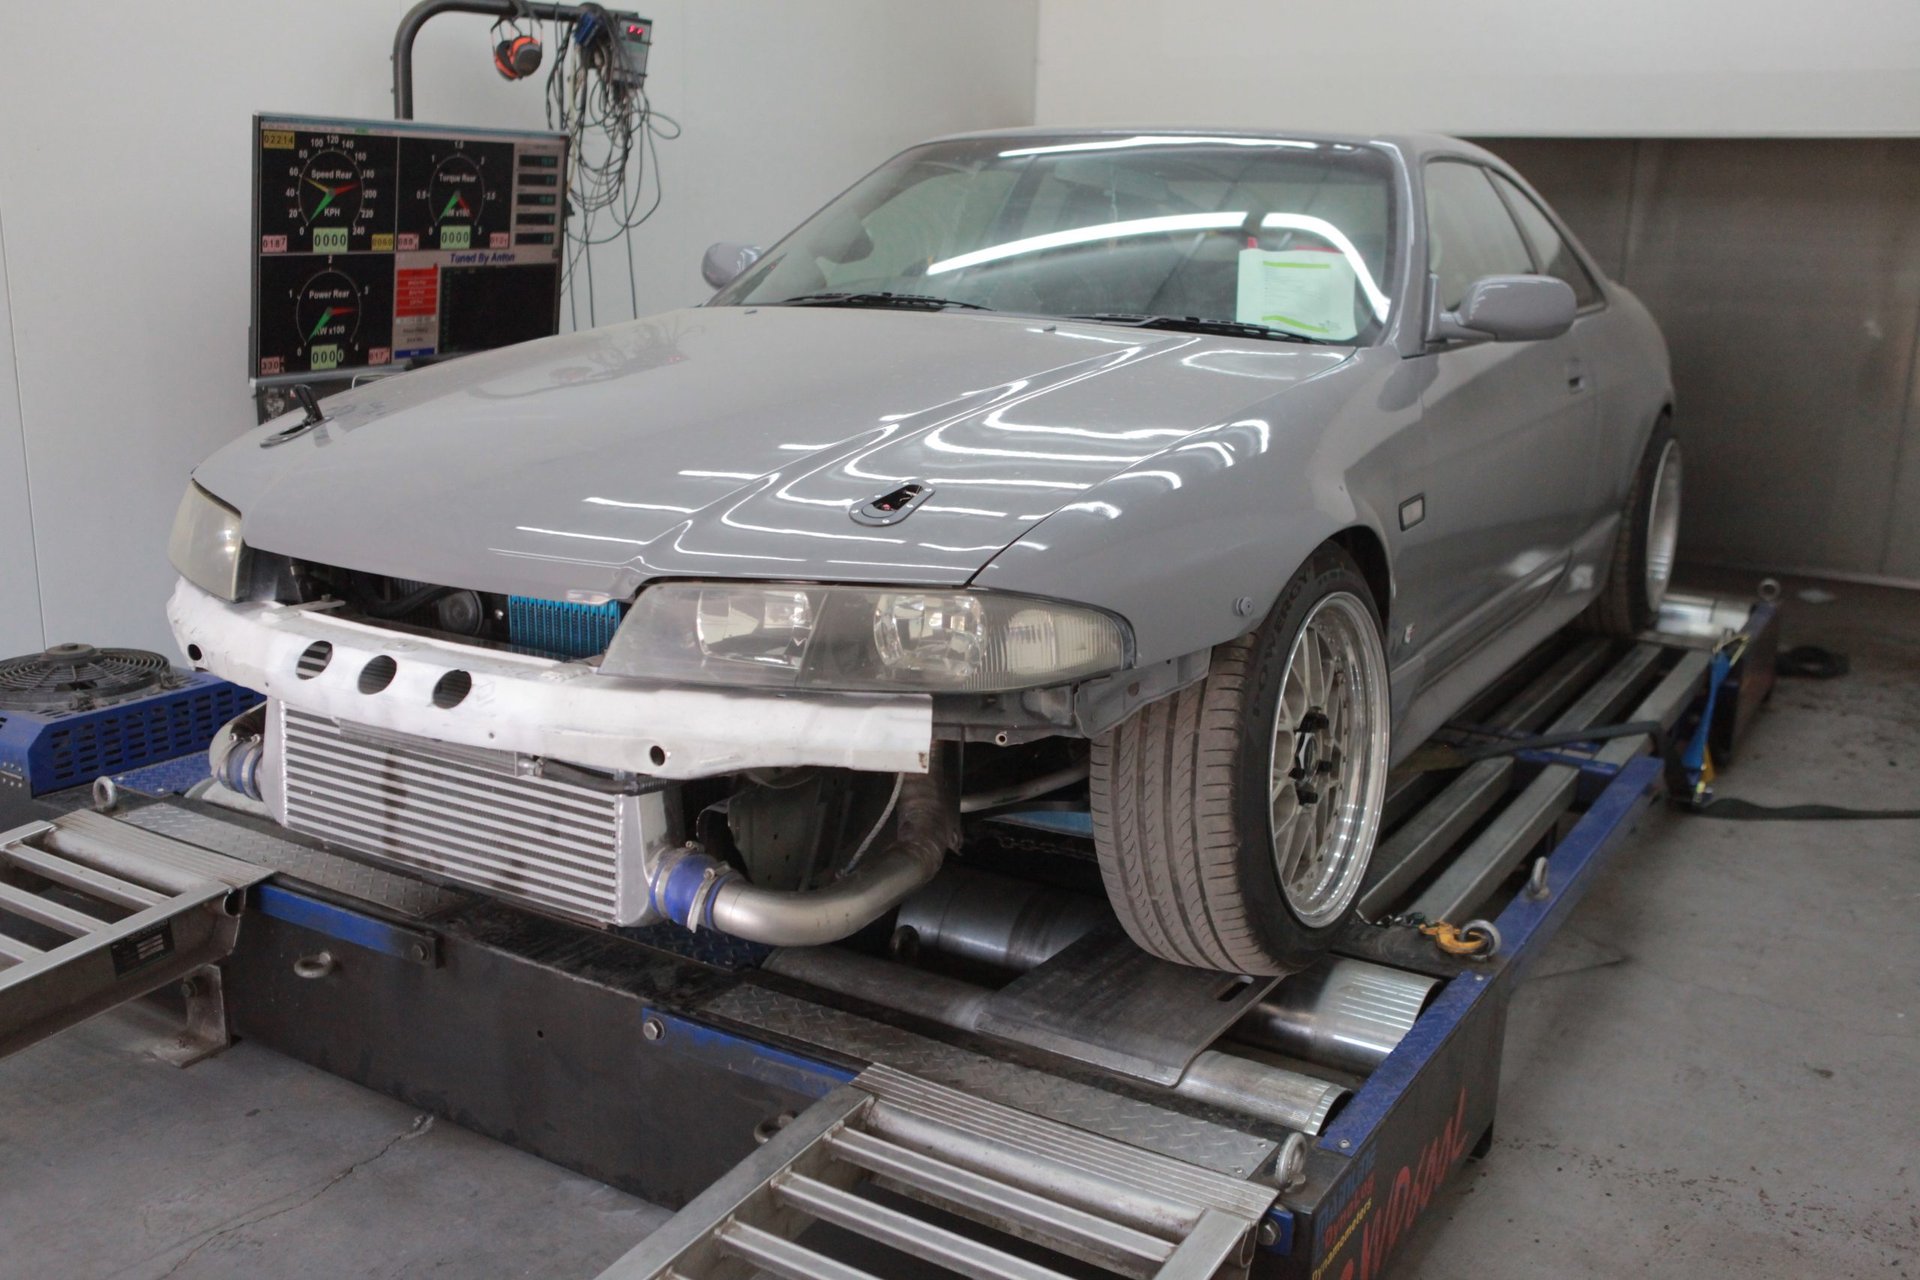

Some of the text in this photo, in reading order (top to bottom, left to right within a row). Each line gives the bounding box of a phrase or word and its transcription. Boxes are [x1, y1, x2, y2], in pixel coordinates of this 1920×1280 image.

[264, 135, 294, 145] 02214
[311, 139, 324, 147] 100
[327, 135, 339, 144] 120
[342, 140, 354, 149] 140
[298, 150, 308, 159] 80
[355, 153, 367, 161] 160
[289, 168, 299, 176] 60
[311, 170, 352, 180] Speed Rear
[363, 171, 375, 179] 180
[439, 173, 477, 184] Torque Rear
[286, 189, 295, 198] 40
[365, 190, 377, 198] 200
[289, 210, 297, 218] 20
[324, 209, 341, 217] KPH
[361, 210, 374, 218] 220
[352, 227, 365, 236] 240
[314, 234, 347, 247] 0000
[441, 232, 470, 244] 0000
[450, 253, 515, 265] Tuned By Anton
[308, 289, 350, 300] Power Rear
[328, 325, 345, 335] x100
[312, 349, 344, 363] 0000
[1312, 1196, 1372, 1280] Dynamometers
